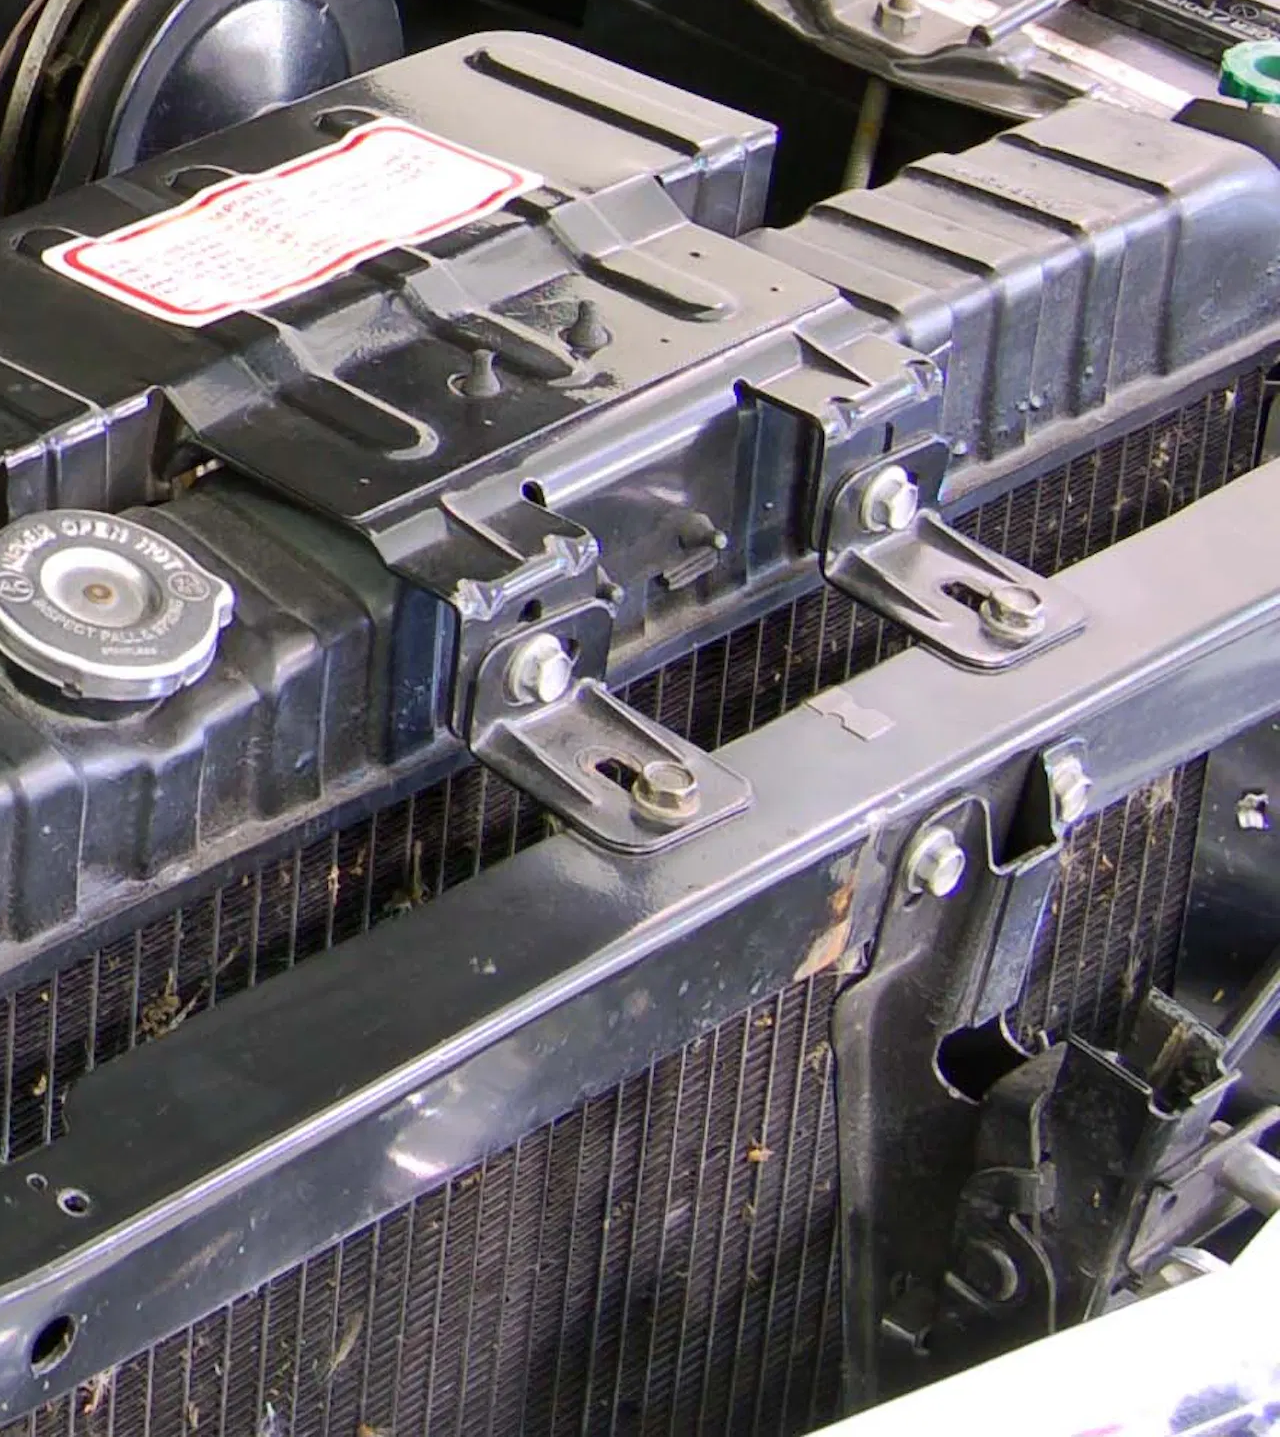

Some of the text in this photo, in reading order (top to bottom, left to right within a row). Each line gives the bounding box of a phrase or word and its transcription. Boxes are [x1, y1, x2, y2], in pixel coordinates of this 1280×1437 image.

[0, 518, 185, 572] NEVER OPEN HOT
